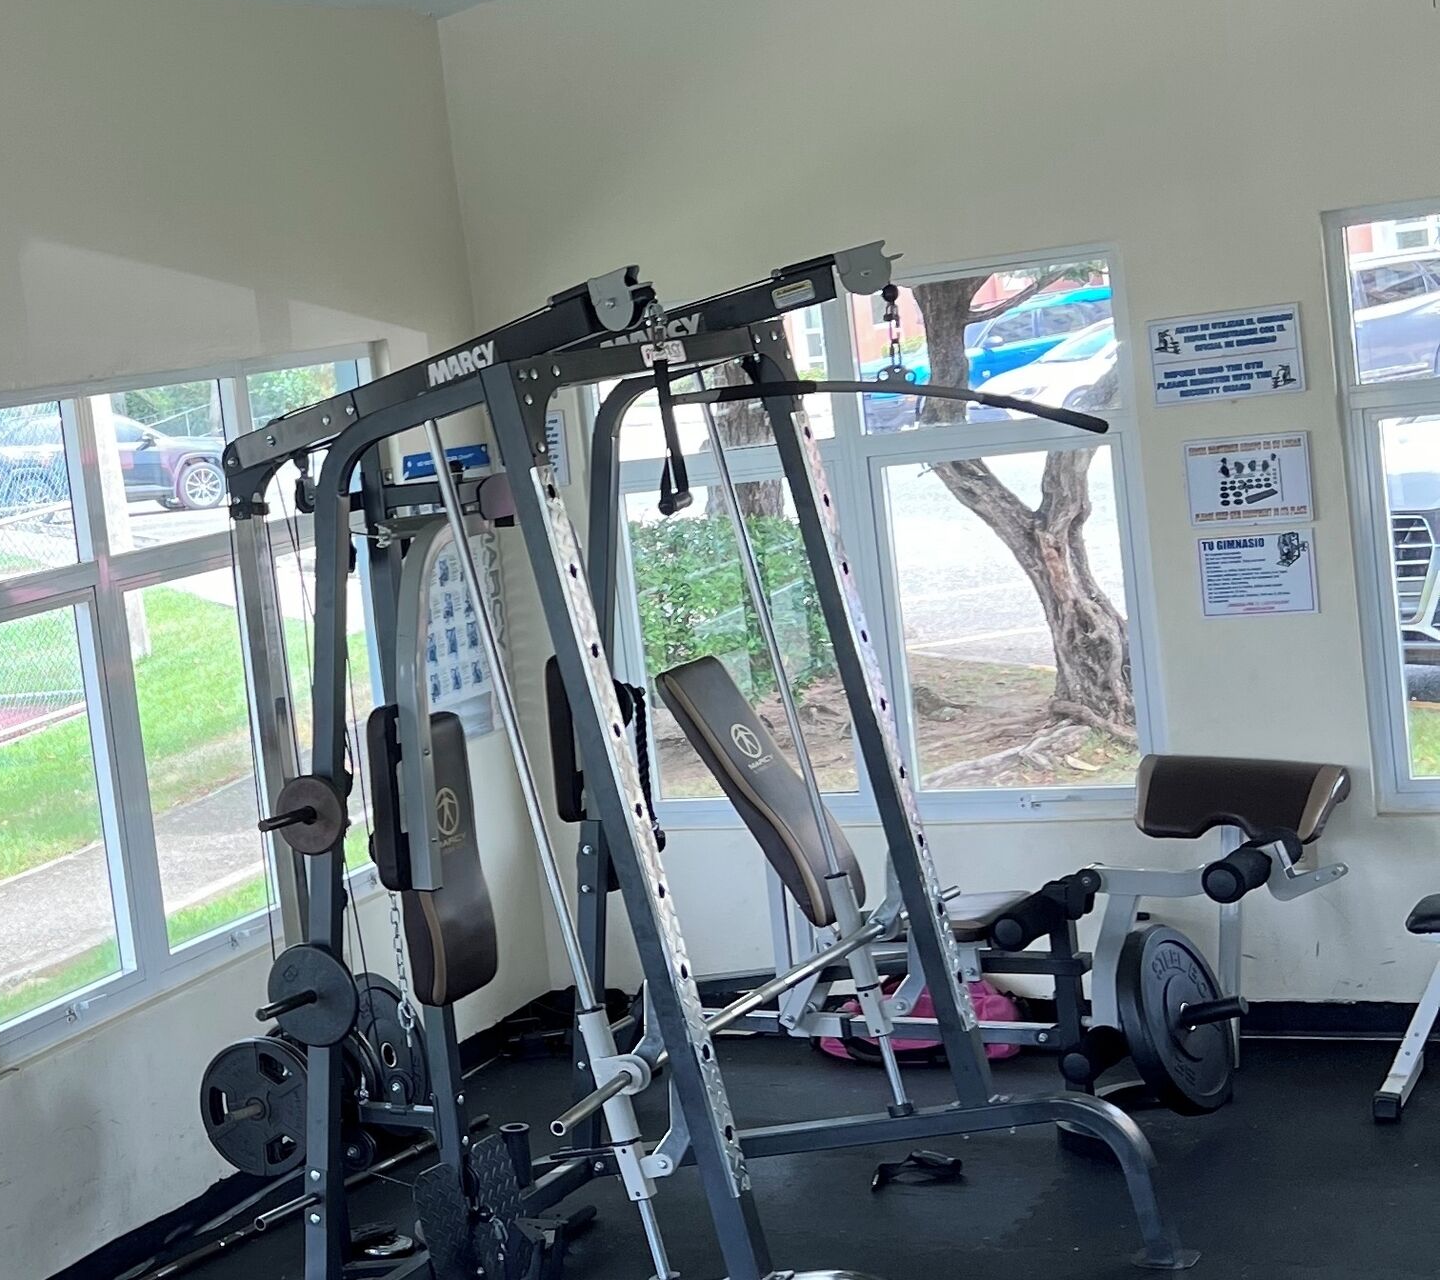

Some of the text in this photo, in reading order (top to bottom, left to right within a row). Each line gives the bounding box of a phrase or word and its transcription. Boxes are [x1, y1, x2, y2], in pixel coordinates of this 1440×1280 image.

[427, 340, 495, 388] MARCY
[1201, 537, 1265, 552] TU GIMNASIO
